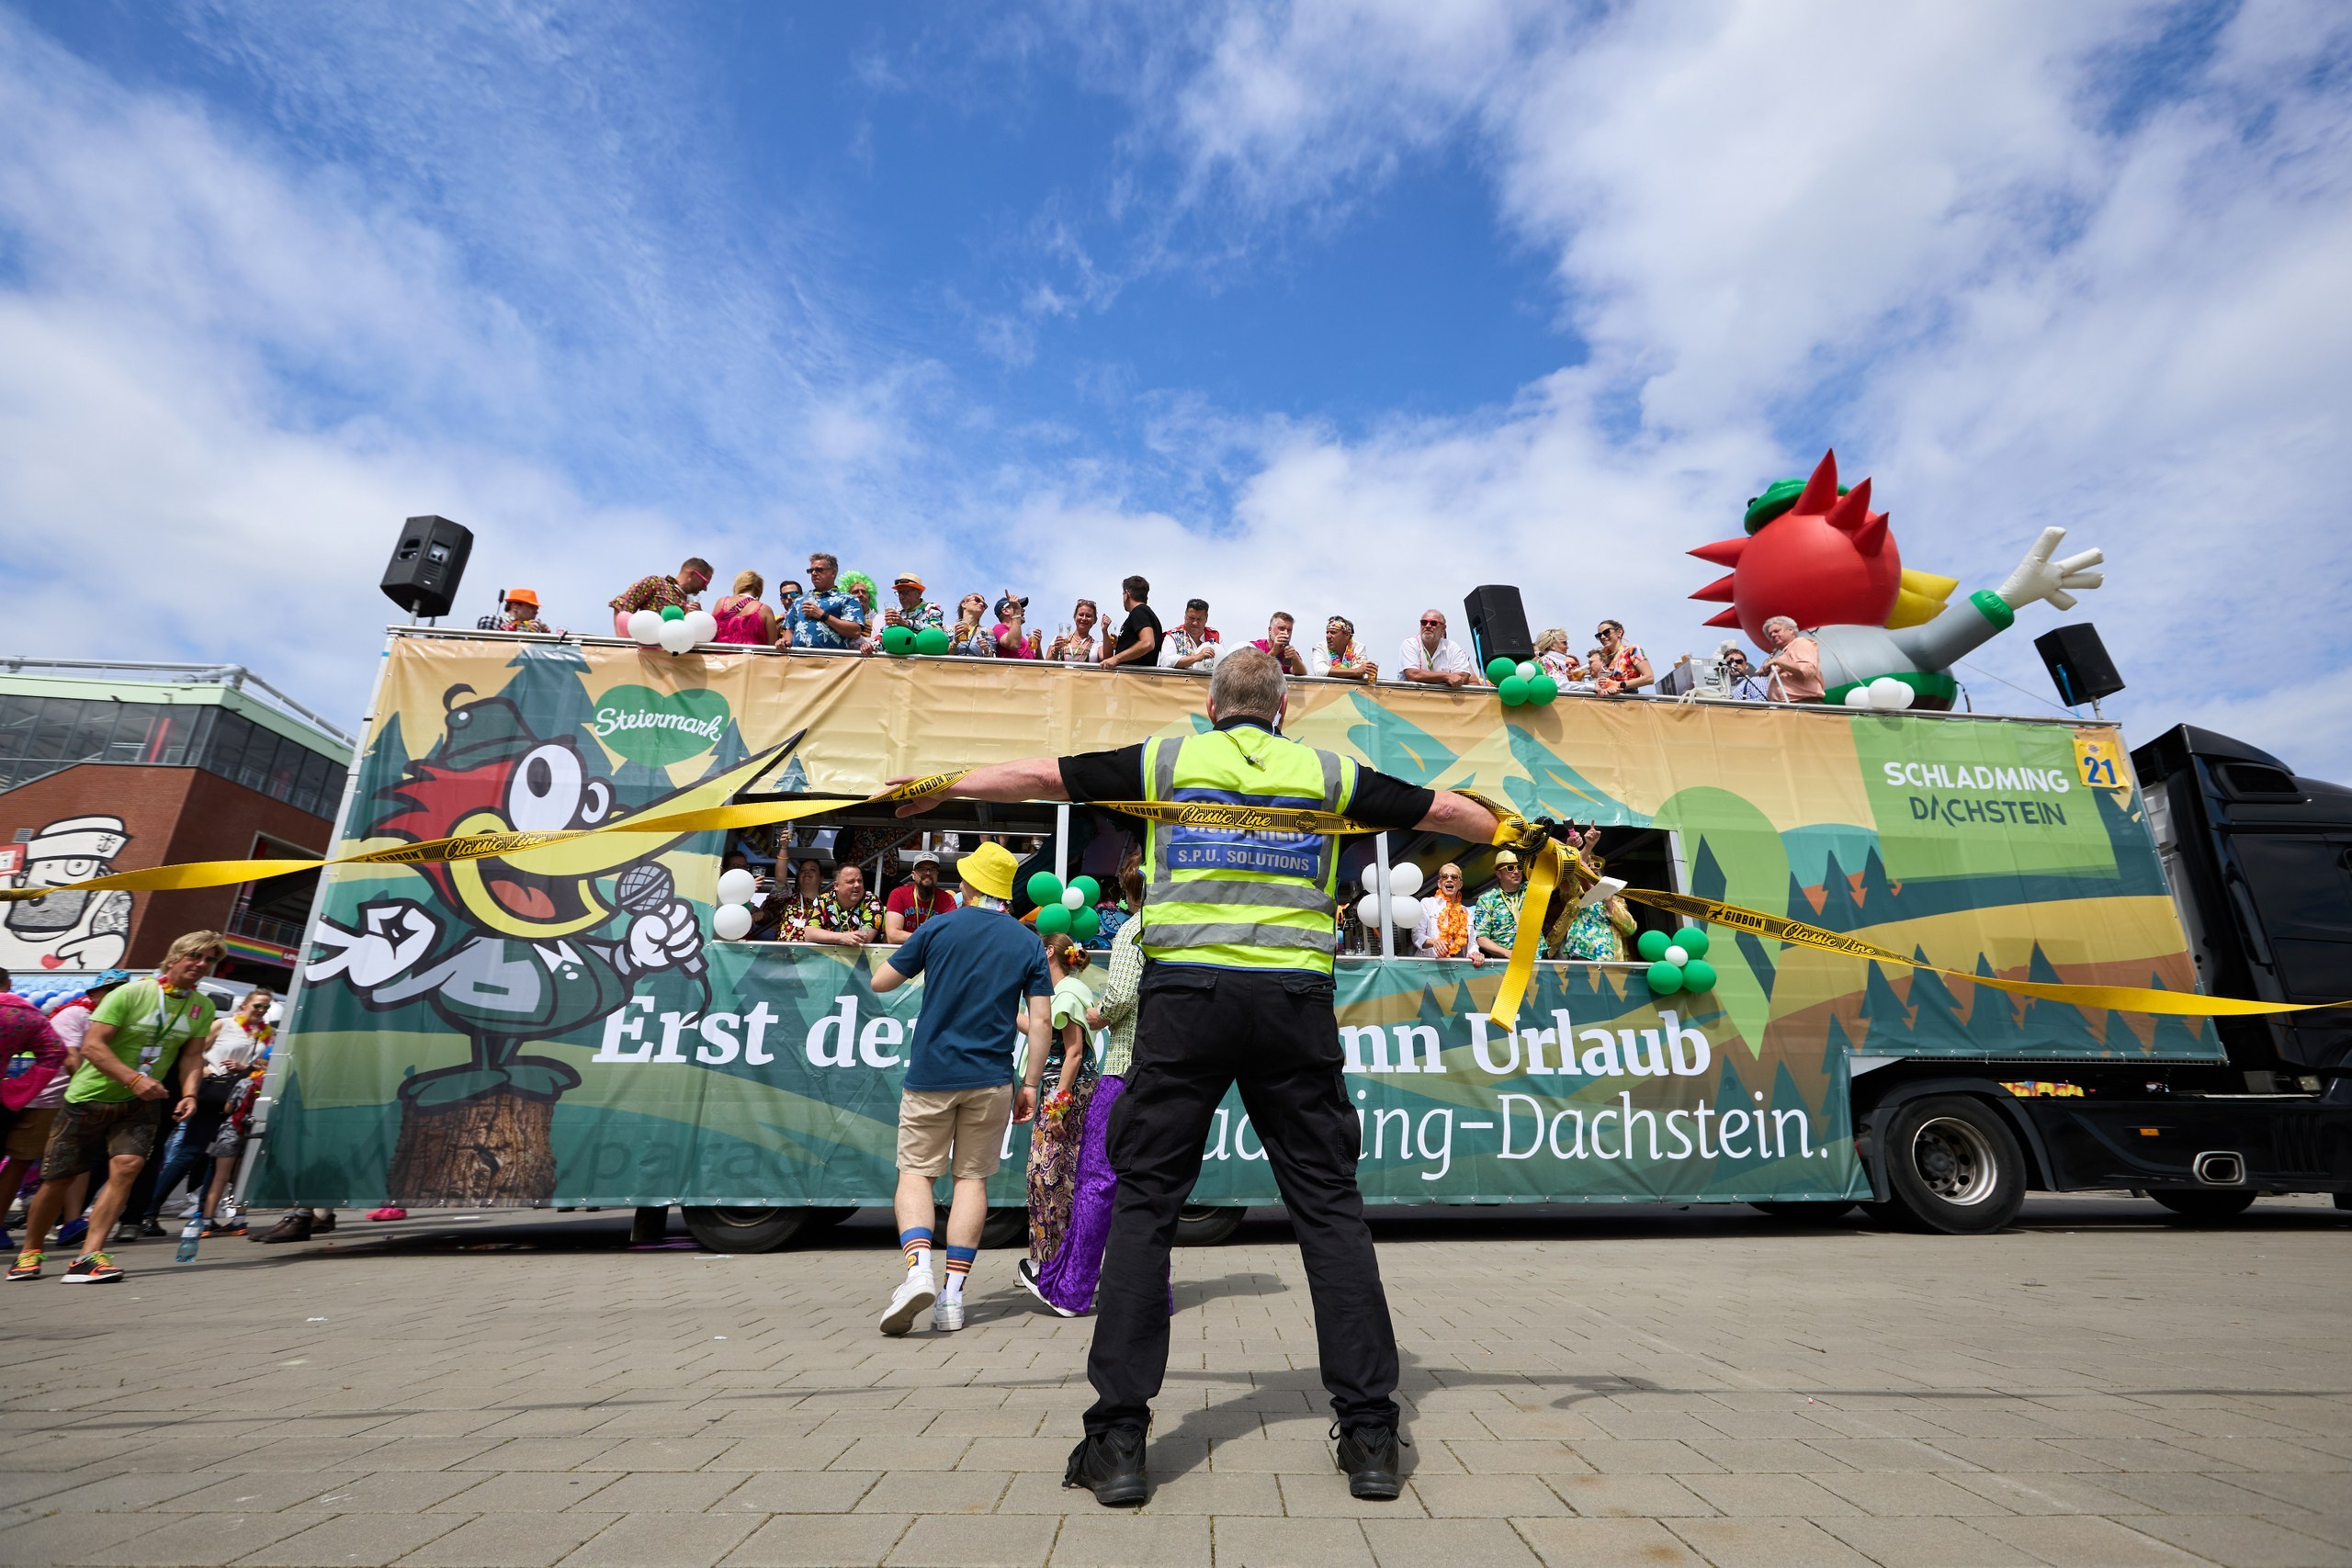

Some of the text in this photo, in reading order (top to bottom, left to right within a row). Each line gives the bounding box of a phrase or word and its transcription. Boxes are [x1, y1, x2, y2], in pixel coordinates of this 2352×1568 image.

[594, 708, 722, 741] Steiermark
[909, 775, 944, 796] GIBBON
[1883, 761, 2070, 793] SCHLADMING
[2084, 756, 2117, 784] 21
[1124, 805, 1272, 829] GIBBON Classic Line
[1909, 794, 2067, 827] DACHSTEIN
[376, 832, 547, 862] GIBBON Classic Line
[1178, 849, 1310, 872] S.P.U. SOLUTIONS
[1724, 909, 1877, 956] GIBBON Classic Line
[592, 995, 779, 1066] Erst
[1338, 1025, 1447, 1073] nn
[1465, 1009, 1712, 1077] Urlaub
